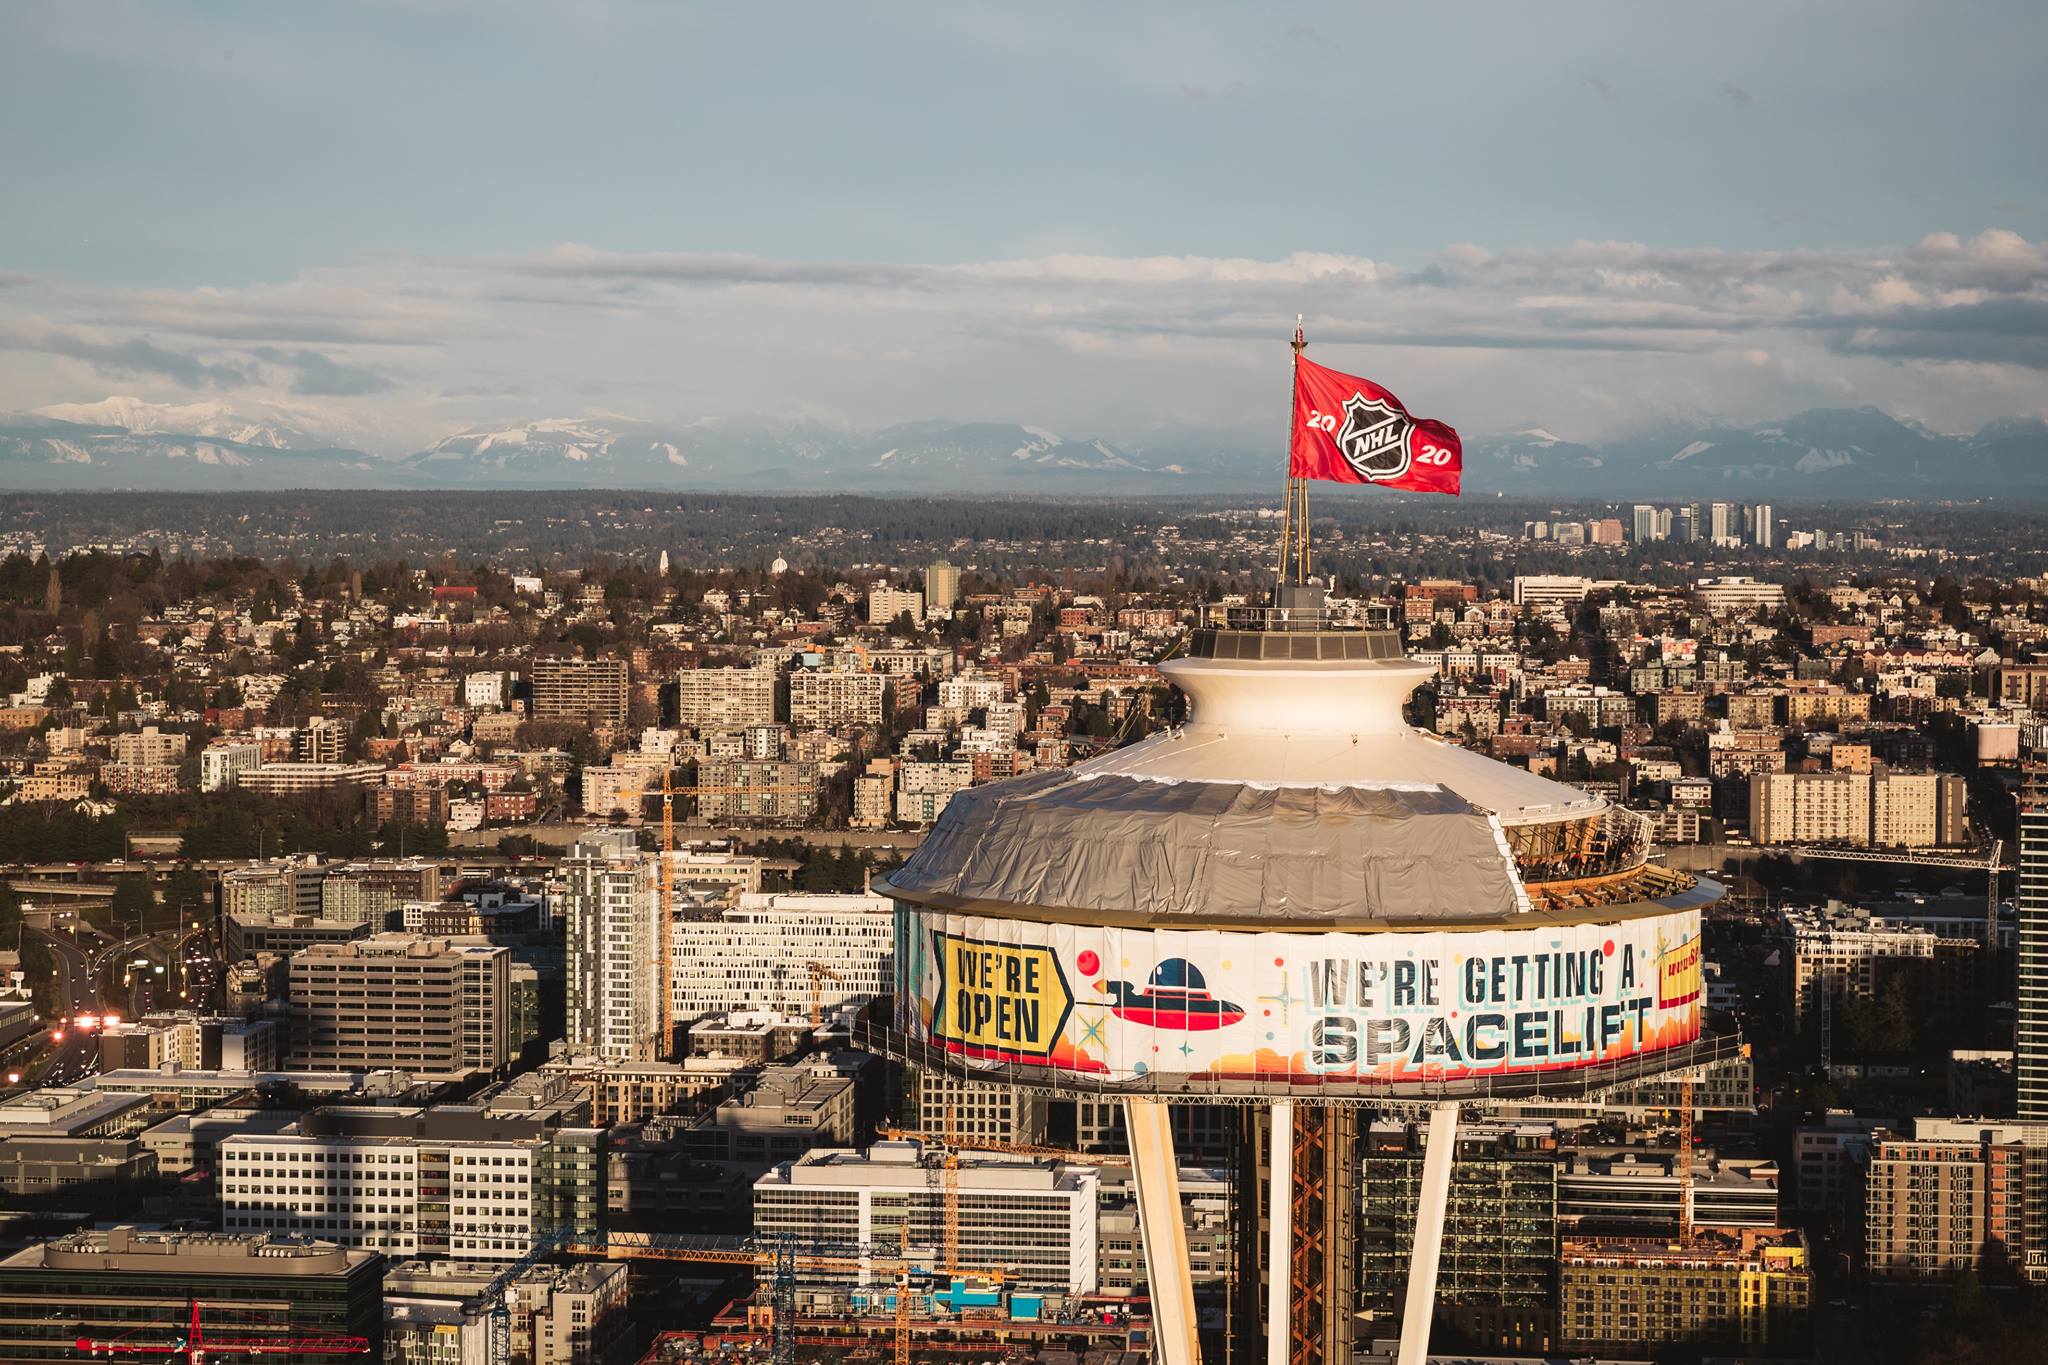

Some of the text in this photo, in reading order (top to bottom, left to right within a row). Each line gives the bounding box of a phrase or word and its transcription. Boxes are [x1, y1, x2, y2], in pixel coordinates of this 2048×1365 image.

[1306, 410, 1336, 432] 20
[1353, 424, 1399, 457] NHL
[1416, 445, 1452, 466] 20
[956, 947, 1040, 994] WE'RE
[1310, 943, 1635, 1008] WE'RE GETTING A
[957, 988, 1039, 1044] OPEN
[1311, 997, 1653, 1066] SPACELIFT
